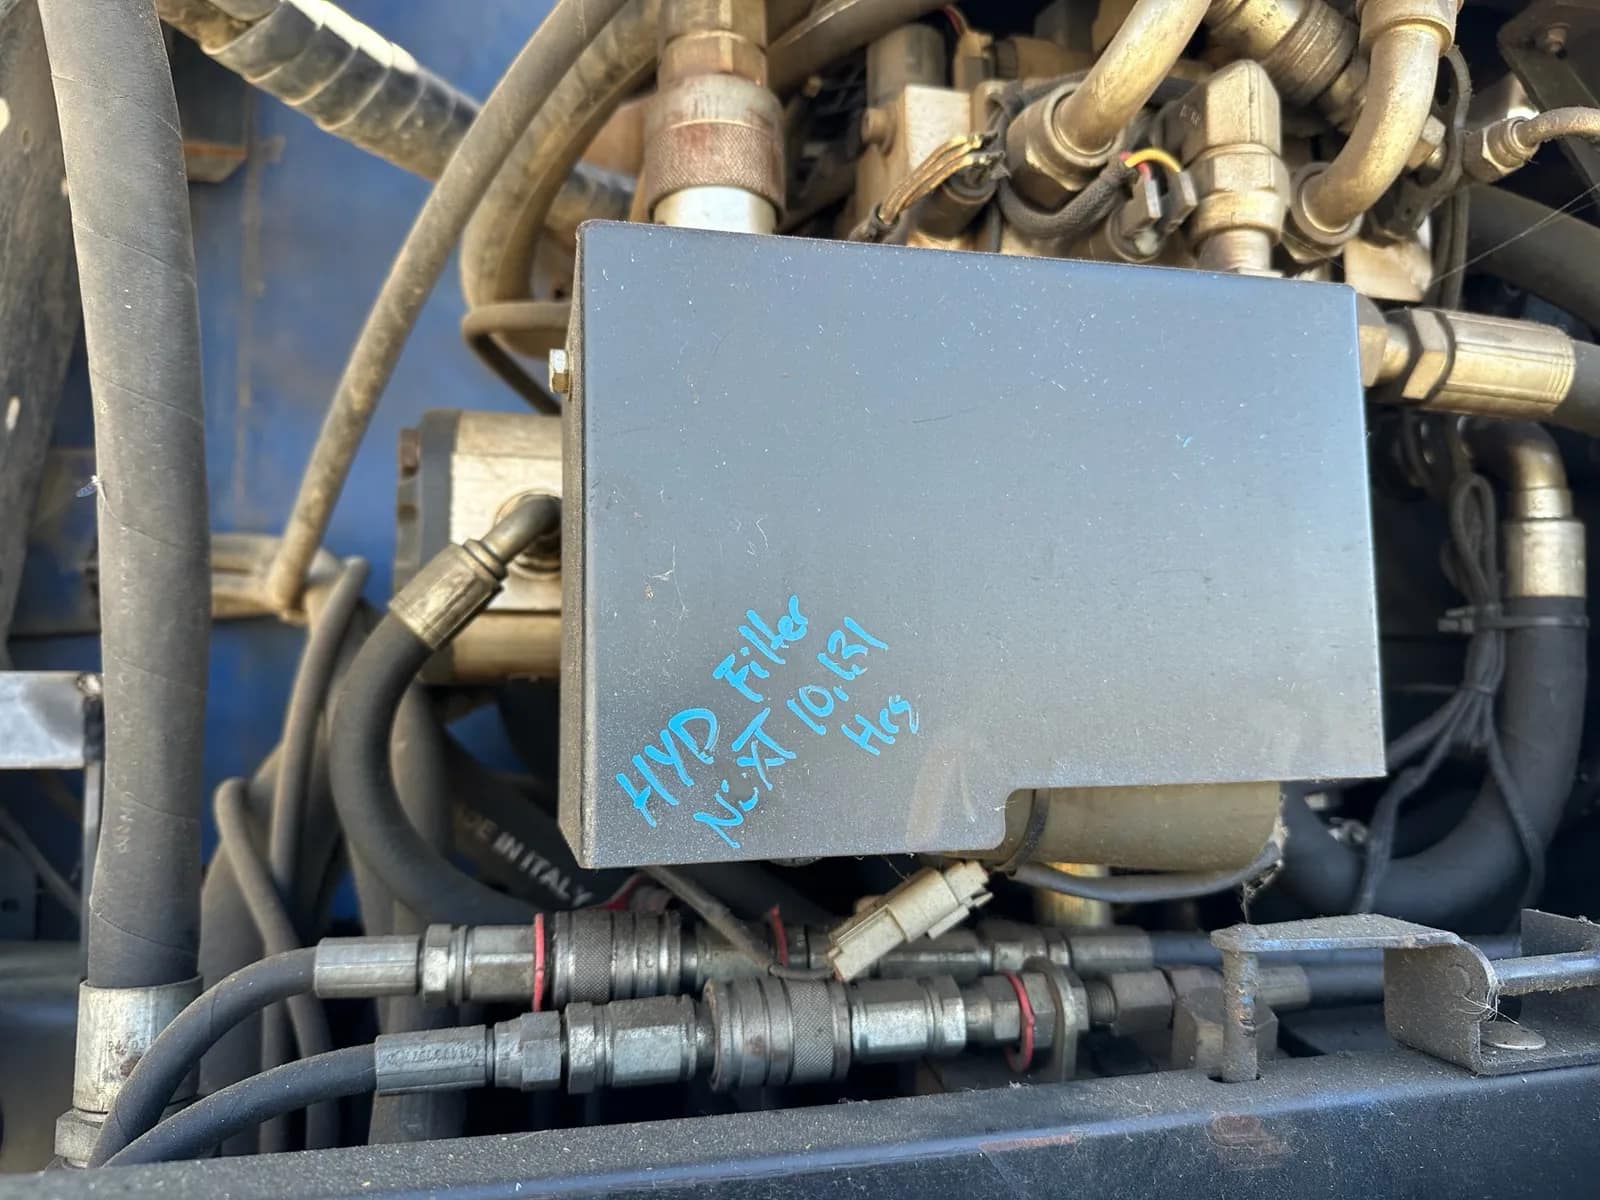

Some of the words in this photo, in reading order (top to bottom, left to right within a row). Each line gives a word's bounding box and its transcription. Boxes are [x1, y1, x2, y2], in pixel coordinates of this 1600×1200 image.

[615, 707, 718, 827] HYD
[712, 595, 808, 703] Filter
[841, 694, 919, 755] Hrs
[490, 831, 526, 864] IN
[518, 850, 594, 907] ITALY
